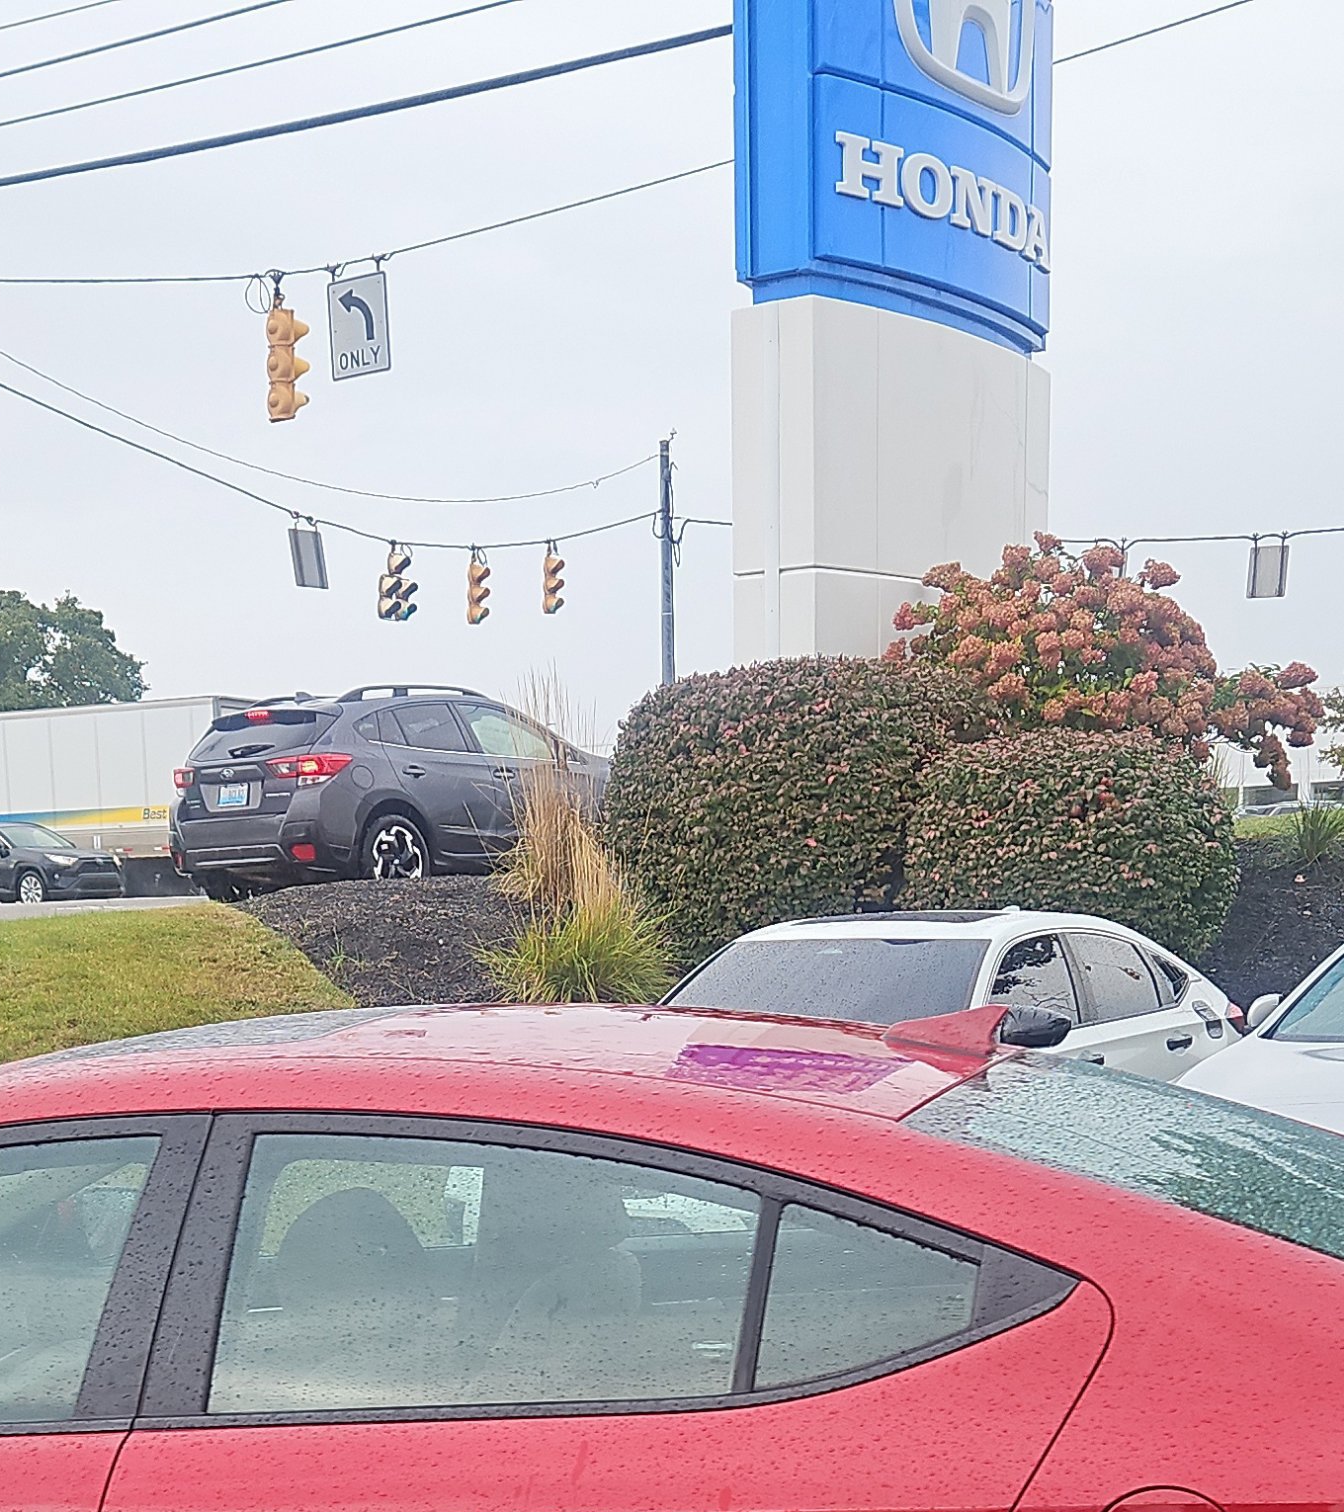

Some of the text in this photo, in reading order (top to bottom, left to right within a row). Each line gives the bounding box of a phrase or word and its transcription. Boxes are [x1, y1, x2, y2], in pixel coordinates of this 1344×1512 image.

[834, 130, 1051, 274] HONDA
[340, 345, 380, 370] ONLY
[143, 808, 167, 820] Best
